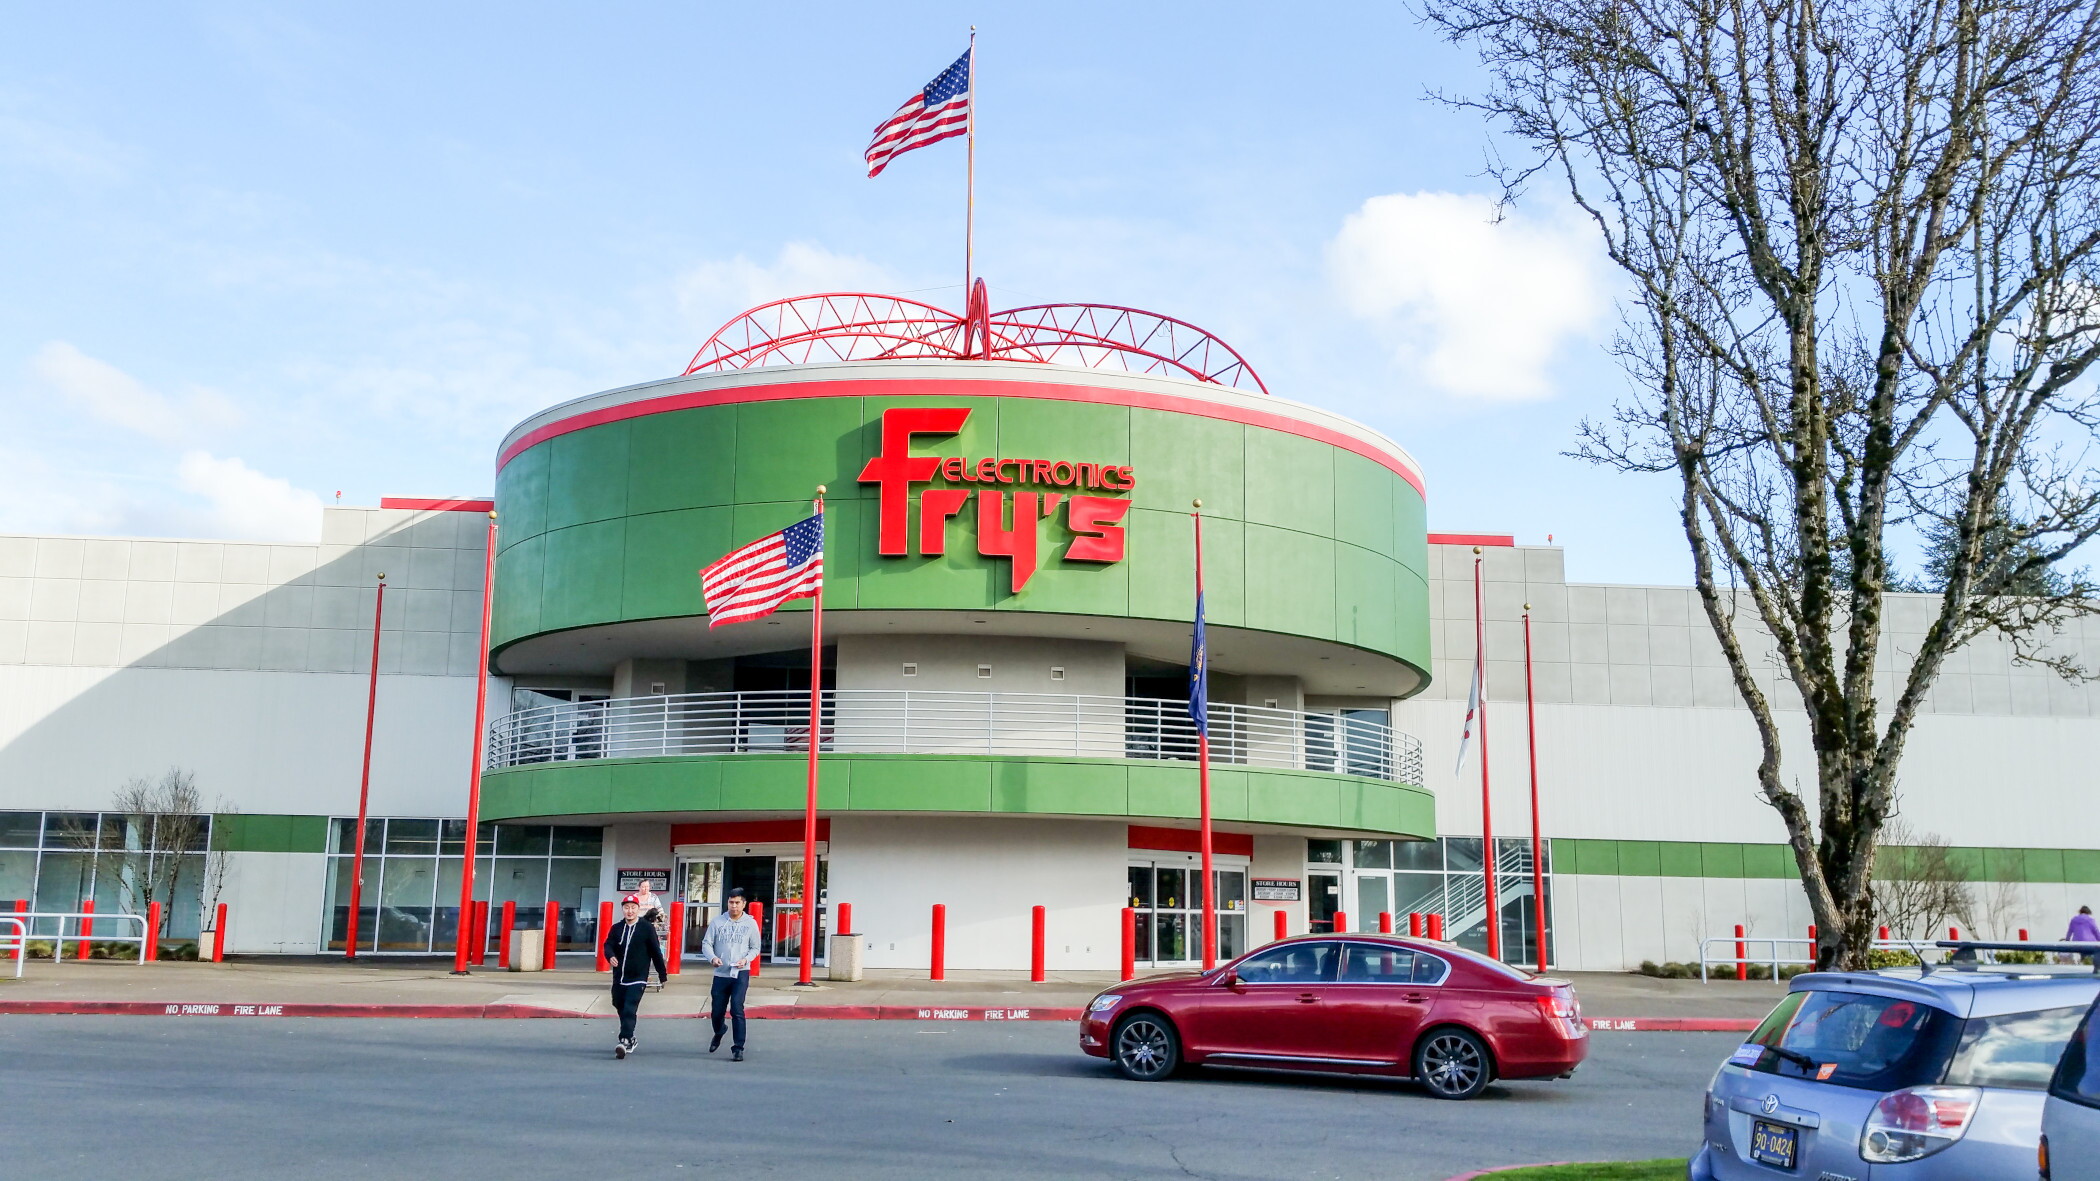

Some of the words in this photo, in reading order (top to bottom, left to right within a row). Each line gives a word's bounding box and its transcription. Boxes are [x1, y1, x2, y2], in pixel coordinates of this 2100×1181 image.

[941, 457, 1136, 490] ELECTRONICS
[165, 1005, 178, 1014] NO
[182, 1005, 219, 1014] PARKING
[234, 1006, 255, 1015] FIRE
[259, 1006, 283, 1015] LANE
[919, 1009, 930, 1018] NO
[934, 1010, 968, 1019] PARKING
[985, 1010, 1004, 1019] FIRE
[1008, 1009, 1029, 1019] LANE
[1593, 1020, 1611, 1029] FIRE
[1615, 1020, 1636, 1029] LANE
